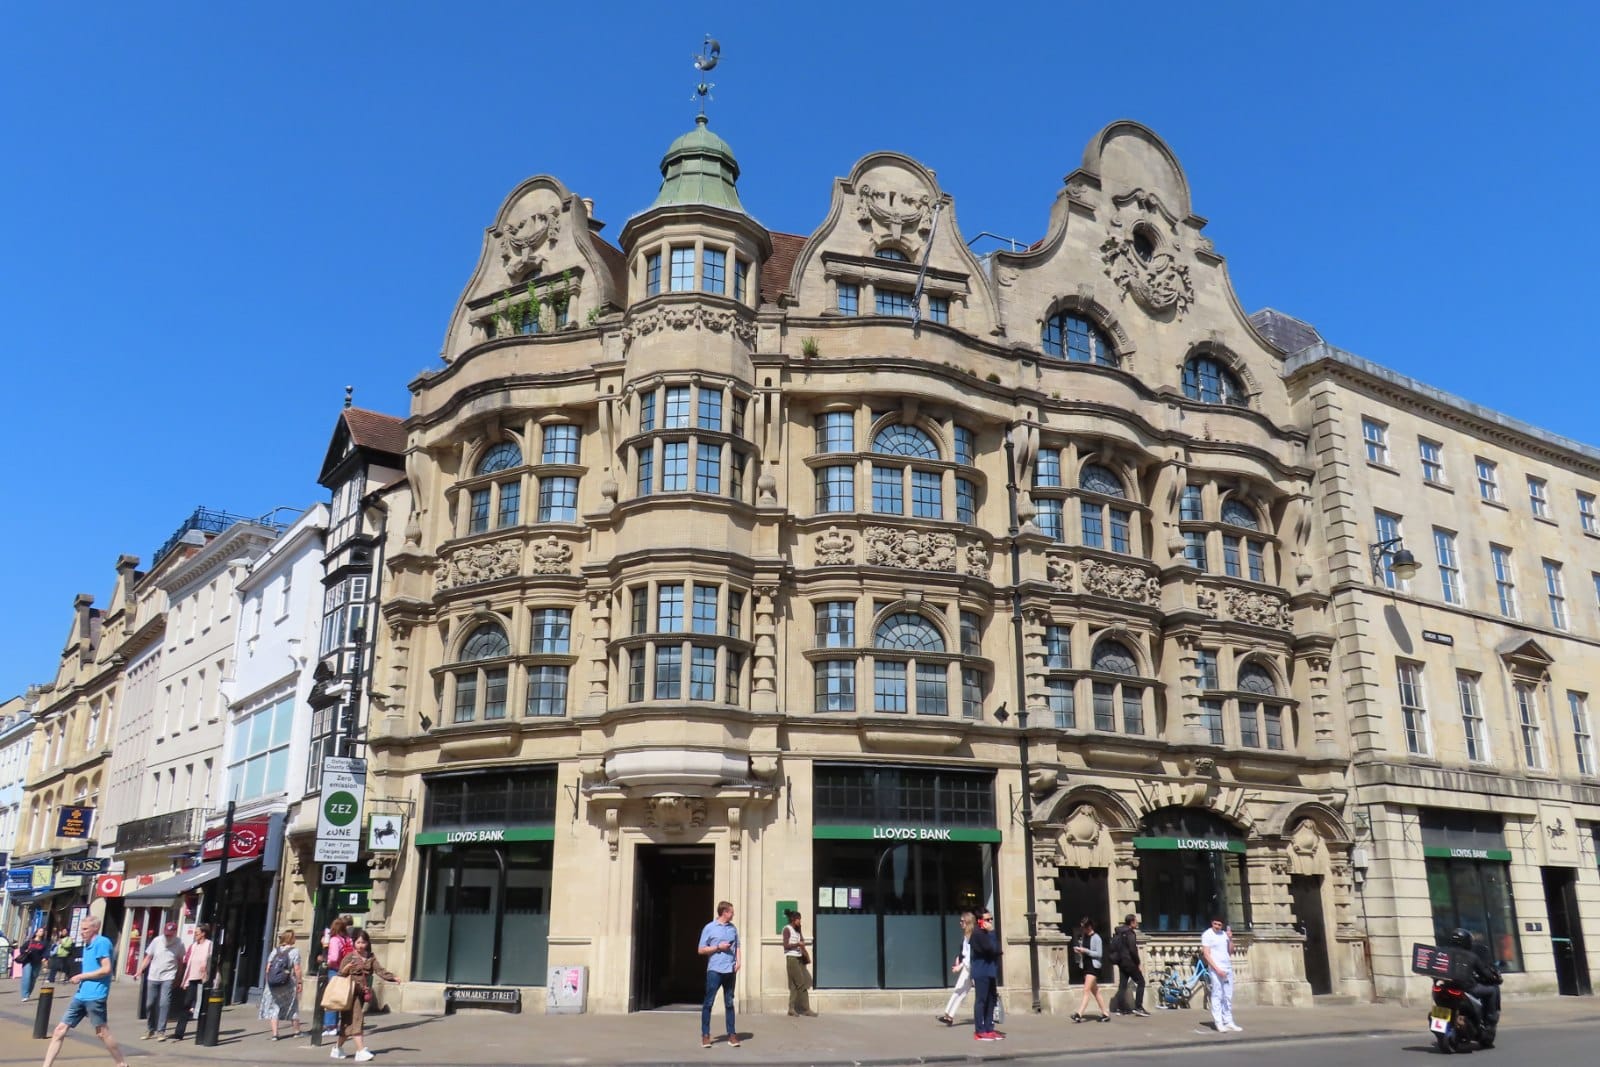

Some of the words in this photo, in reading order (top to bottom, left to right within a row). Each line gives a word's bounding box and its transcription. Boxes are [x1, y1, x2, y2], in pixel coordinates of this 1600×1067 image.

[330, 803, 352, 814] ZEZ
[326, 828, 352, 836] ZONE
[447, 831, 477, 842] LLOYDS
[479, 830, 504, 841] BANK
[873, 827, 917, 839] LLOYDS
[920, 828, 951, 840] BANK
[1177, 839, 1209, 849] LLOYDS
[1210, 840, 1229, 851] BANK
[492, 991, 514, 1000] STREET
[1435, 1020, 1442, 1029] L
